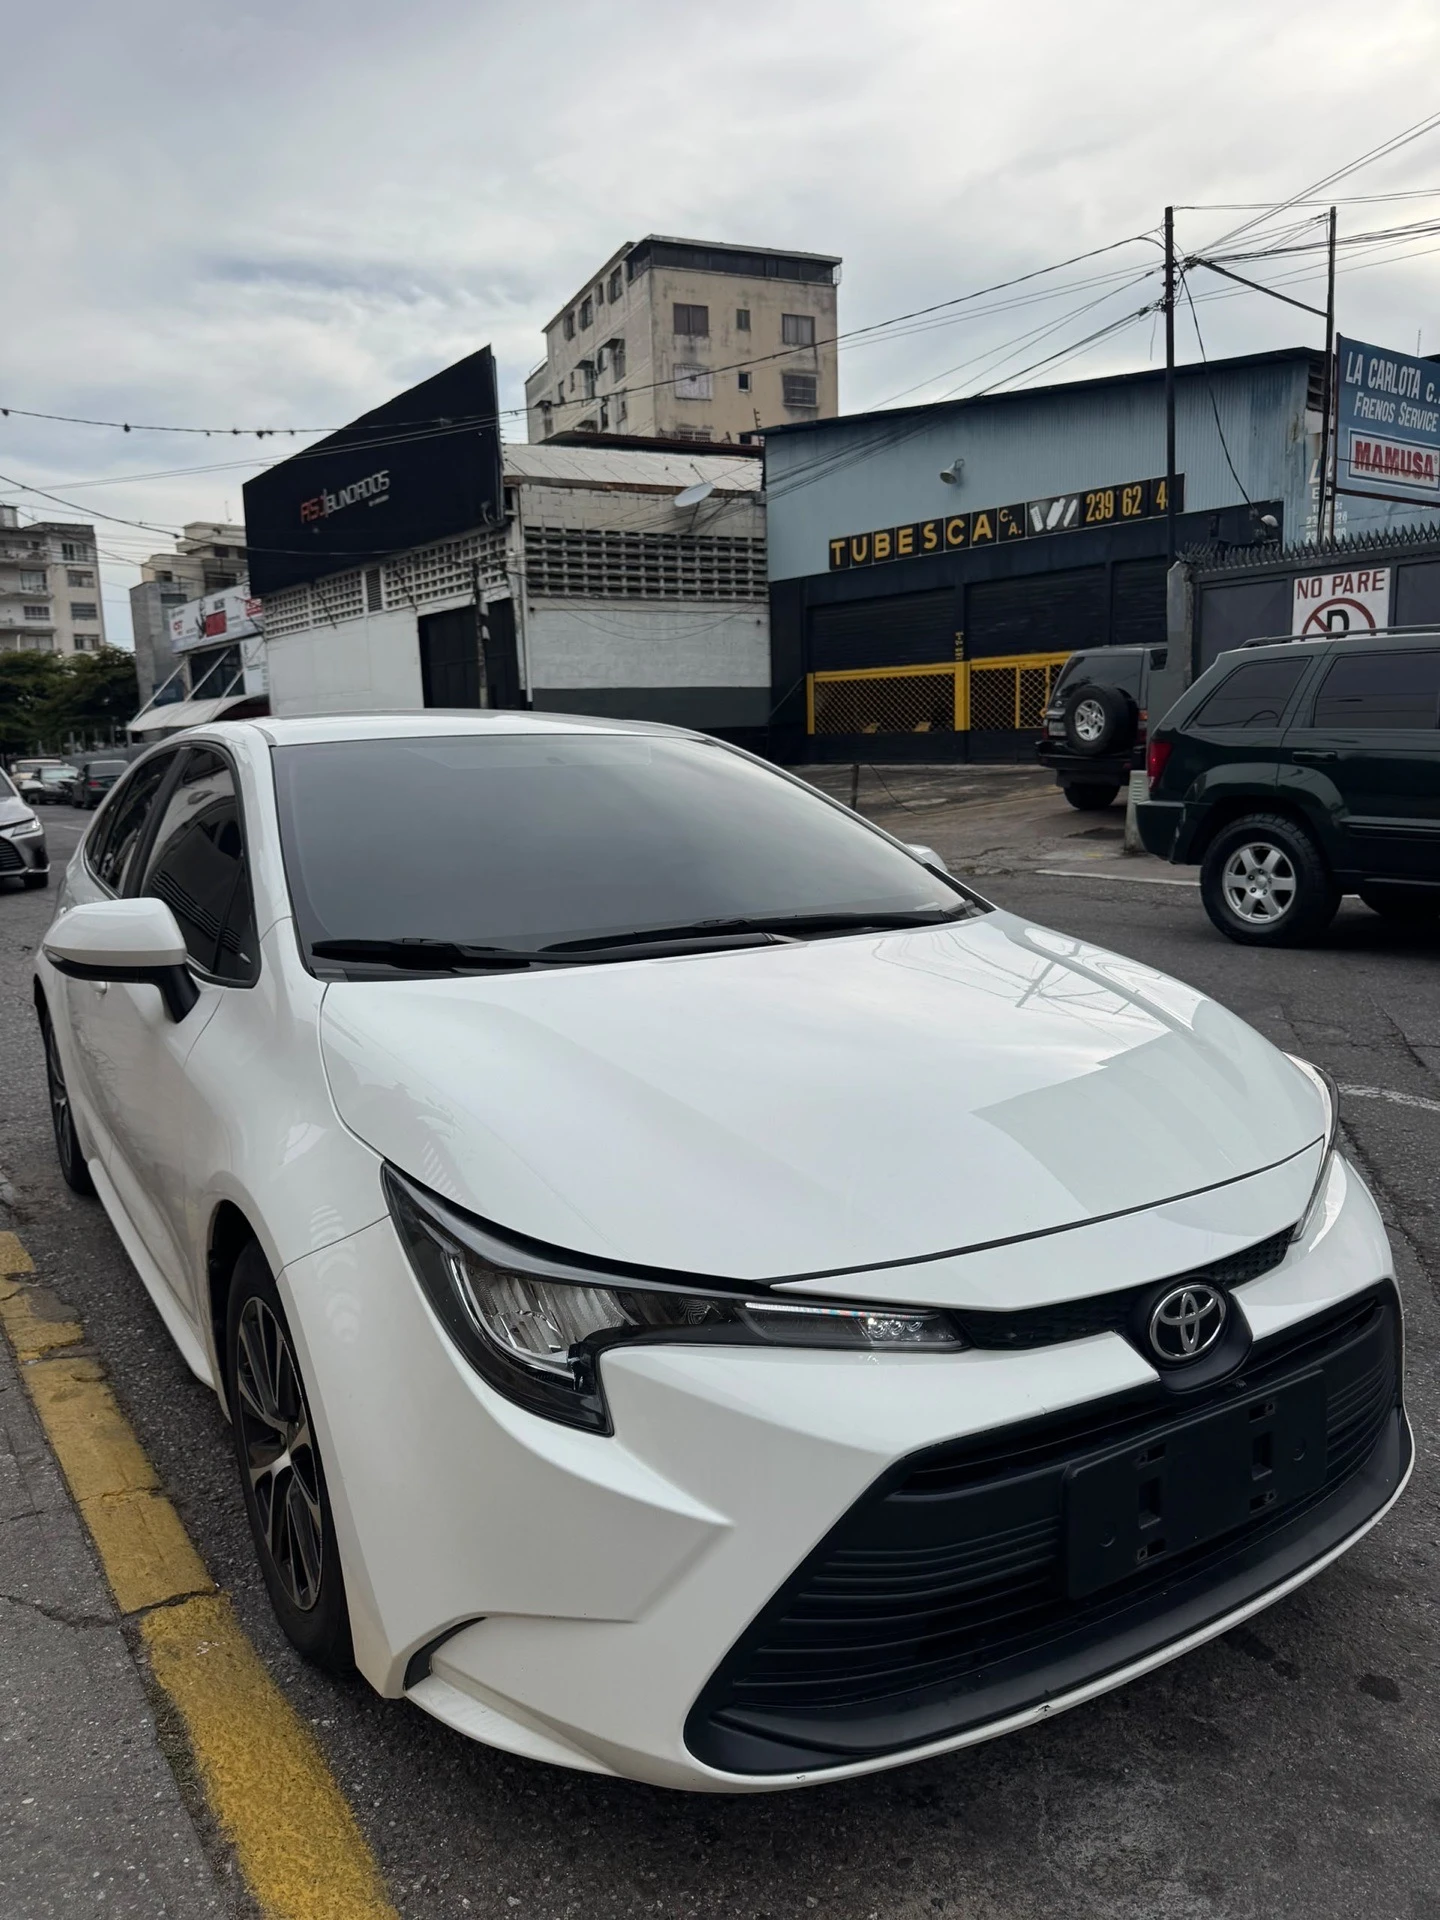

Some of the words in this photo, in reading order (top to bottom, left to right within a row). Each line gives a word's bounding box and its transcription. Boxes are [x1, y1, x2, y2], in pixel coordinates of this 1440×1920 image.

[1345, 351, 1364, 386] LA
[1367, 357, 1422, 400] CARLOTA
[1353, 391, 1396, 424] FRENOS
[1398, 401, 1439, 433] SERVICE
[1354, 440, 1435, 482] MAMUSA
[830, 513, 994, 566] TUBESCA
[1085, 490, 1114, 523] 239
[1122, 484, 1143, 517] 62
[1156, 480, 1169, 511] 4
[1297, 577, 1323, 600] NO
[1331, 569, 1386, 597] PARE
